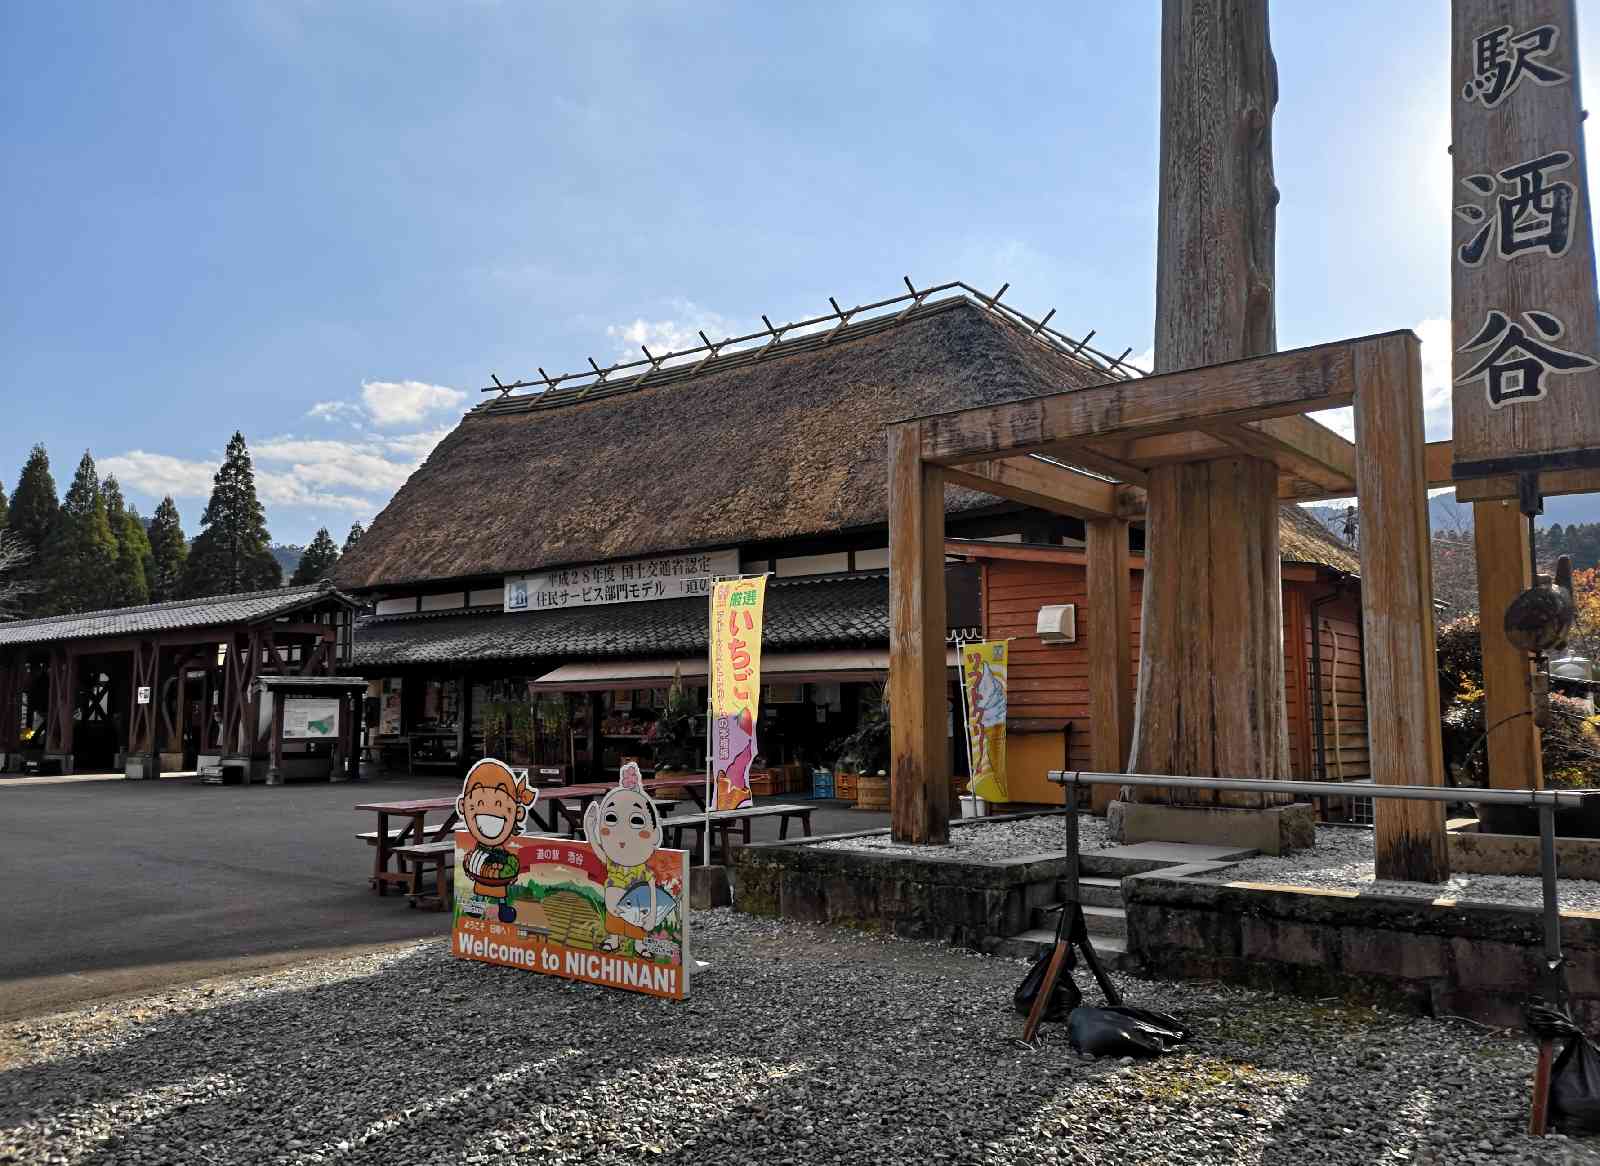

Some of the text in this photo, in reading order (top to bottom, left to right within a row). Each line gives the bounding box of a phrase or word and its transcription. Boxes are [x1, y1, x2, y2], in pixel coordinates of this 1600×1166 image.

[621, 556, 712, 581] 国土交通省認定
[536, 579, 665, 608] 住民サービス部門モデル
[730, 590, 757, 607] 厳選
[728, 609, 754, 701] いちご
[536, 848, 560, 860] 道の駅
[457, 931, 677, 994] Welcome to NICHINAN!
